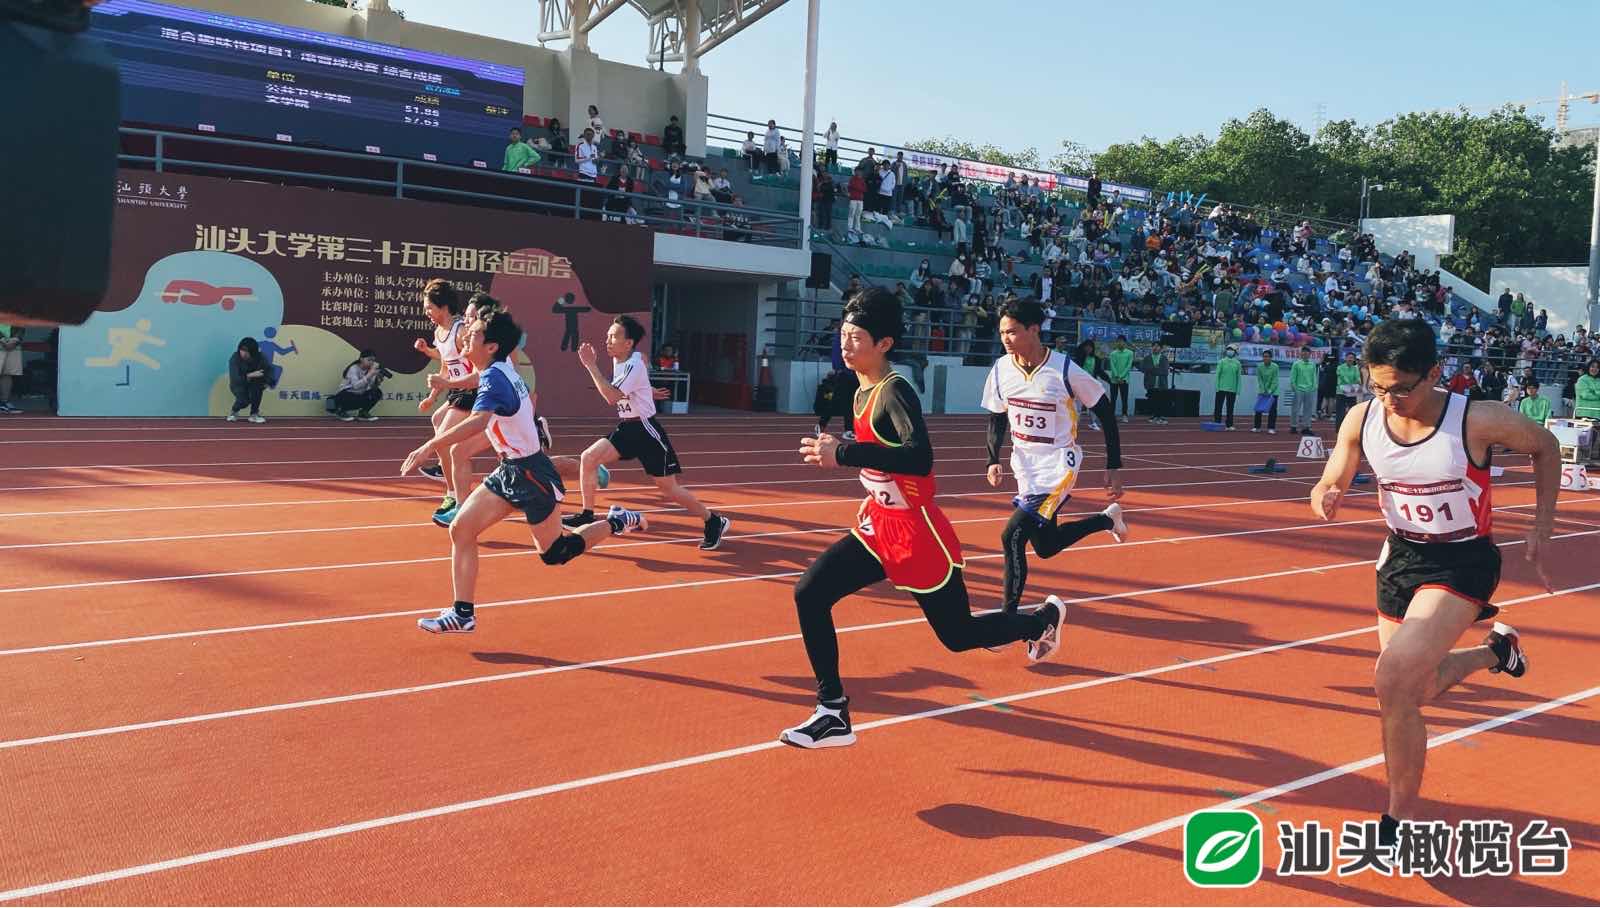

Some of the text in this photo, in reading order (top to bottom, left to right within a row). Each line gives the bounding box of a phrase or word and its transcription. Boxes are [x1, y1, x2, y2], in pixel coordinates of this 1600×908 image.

[194, 224, 573, 279] 汕头大学第三十五届田径运动会
[321, 301, 425, 316] 比赛时间：2021年11
[1015, 412, 1047, 430] 153
[1302, 439, 1314, 457] 8
[1066, 450, 1076, 468] 3
[1560, 467, 1574, 488] 5
[1400, 501, 1454, 524] 191
